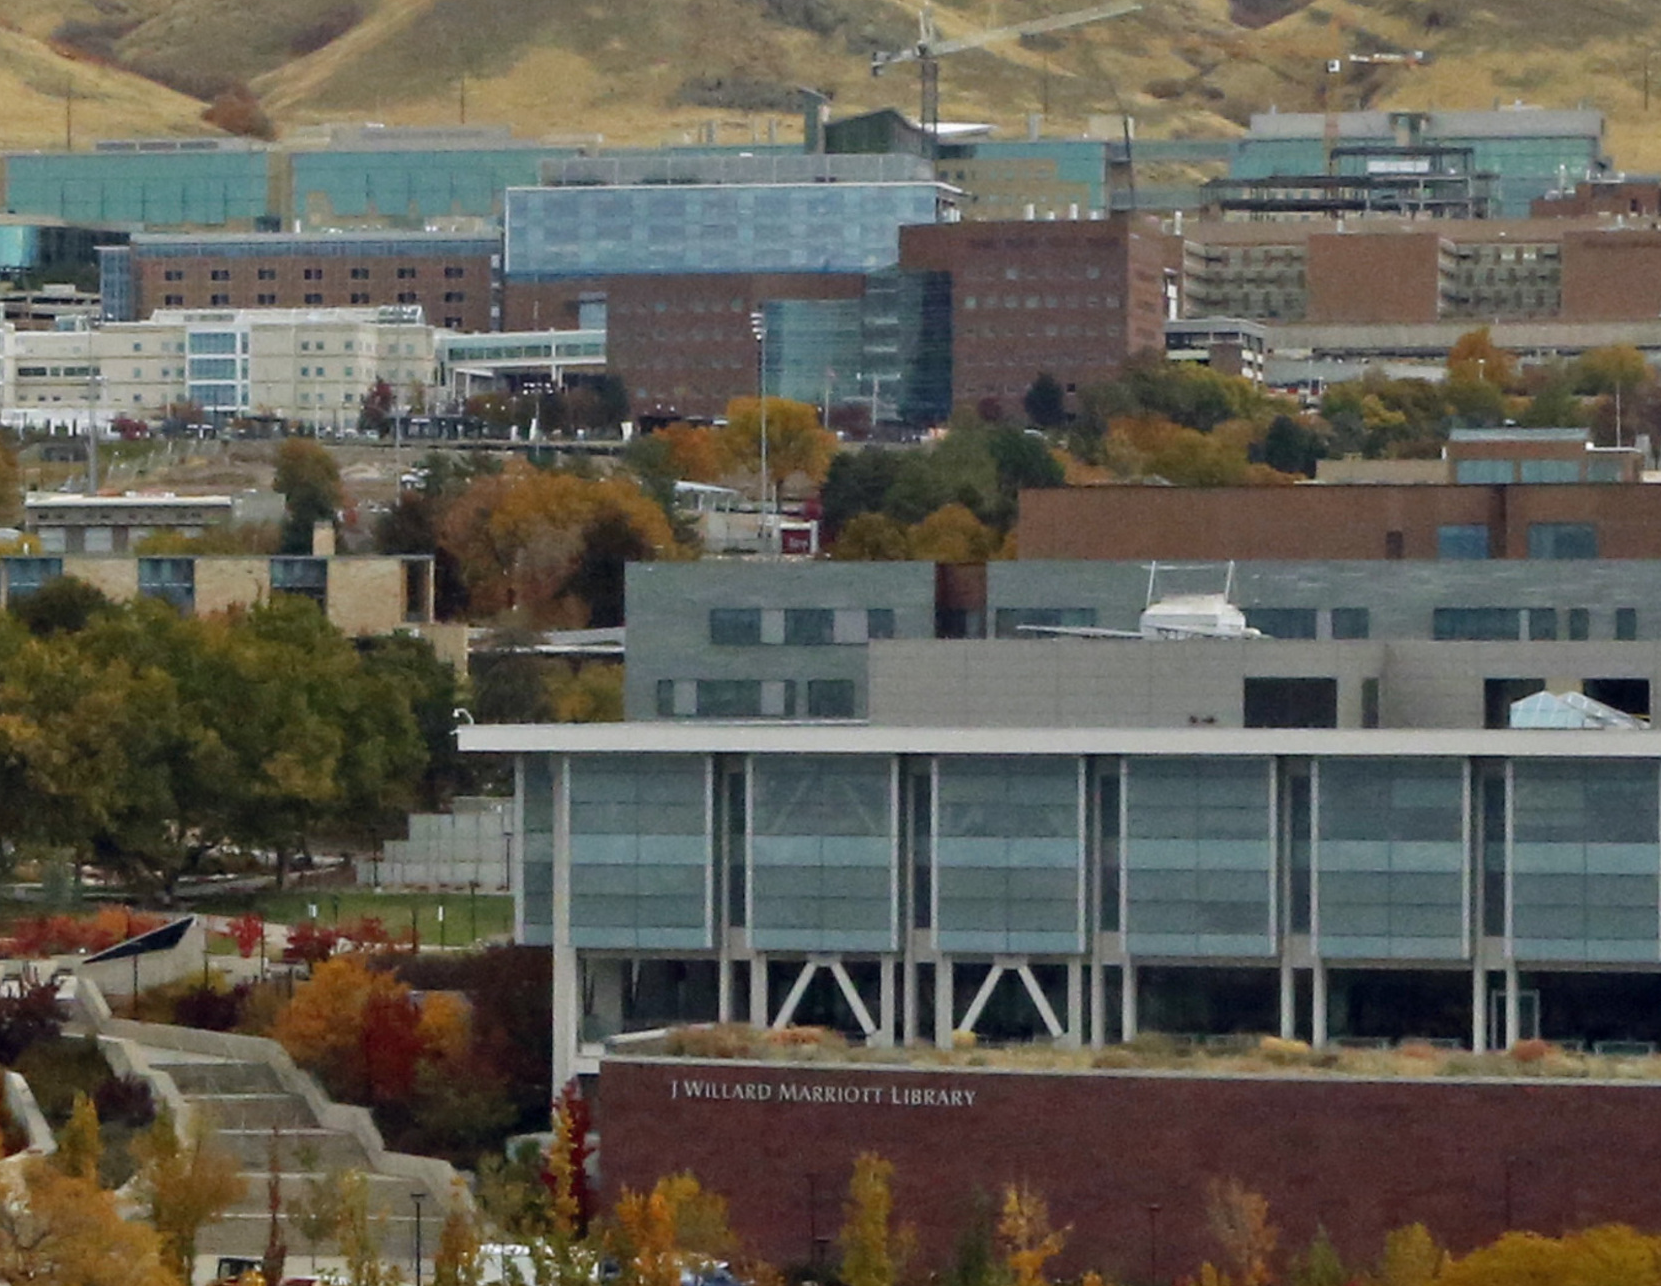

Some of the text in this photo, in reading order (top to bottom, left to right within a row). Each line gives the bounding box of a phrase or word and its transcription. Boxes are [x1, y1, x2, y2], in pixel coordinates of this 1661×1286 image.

[671, 1080, 976, 1106] J WILLARD MARRIOTT LIBRARY
